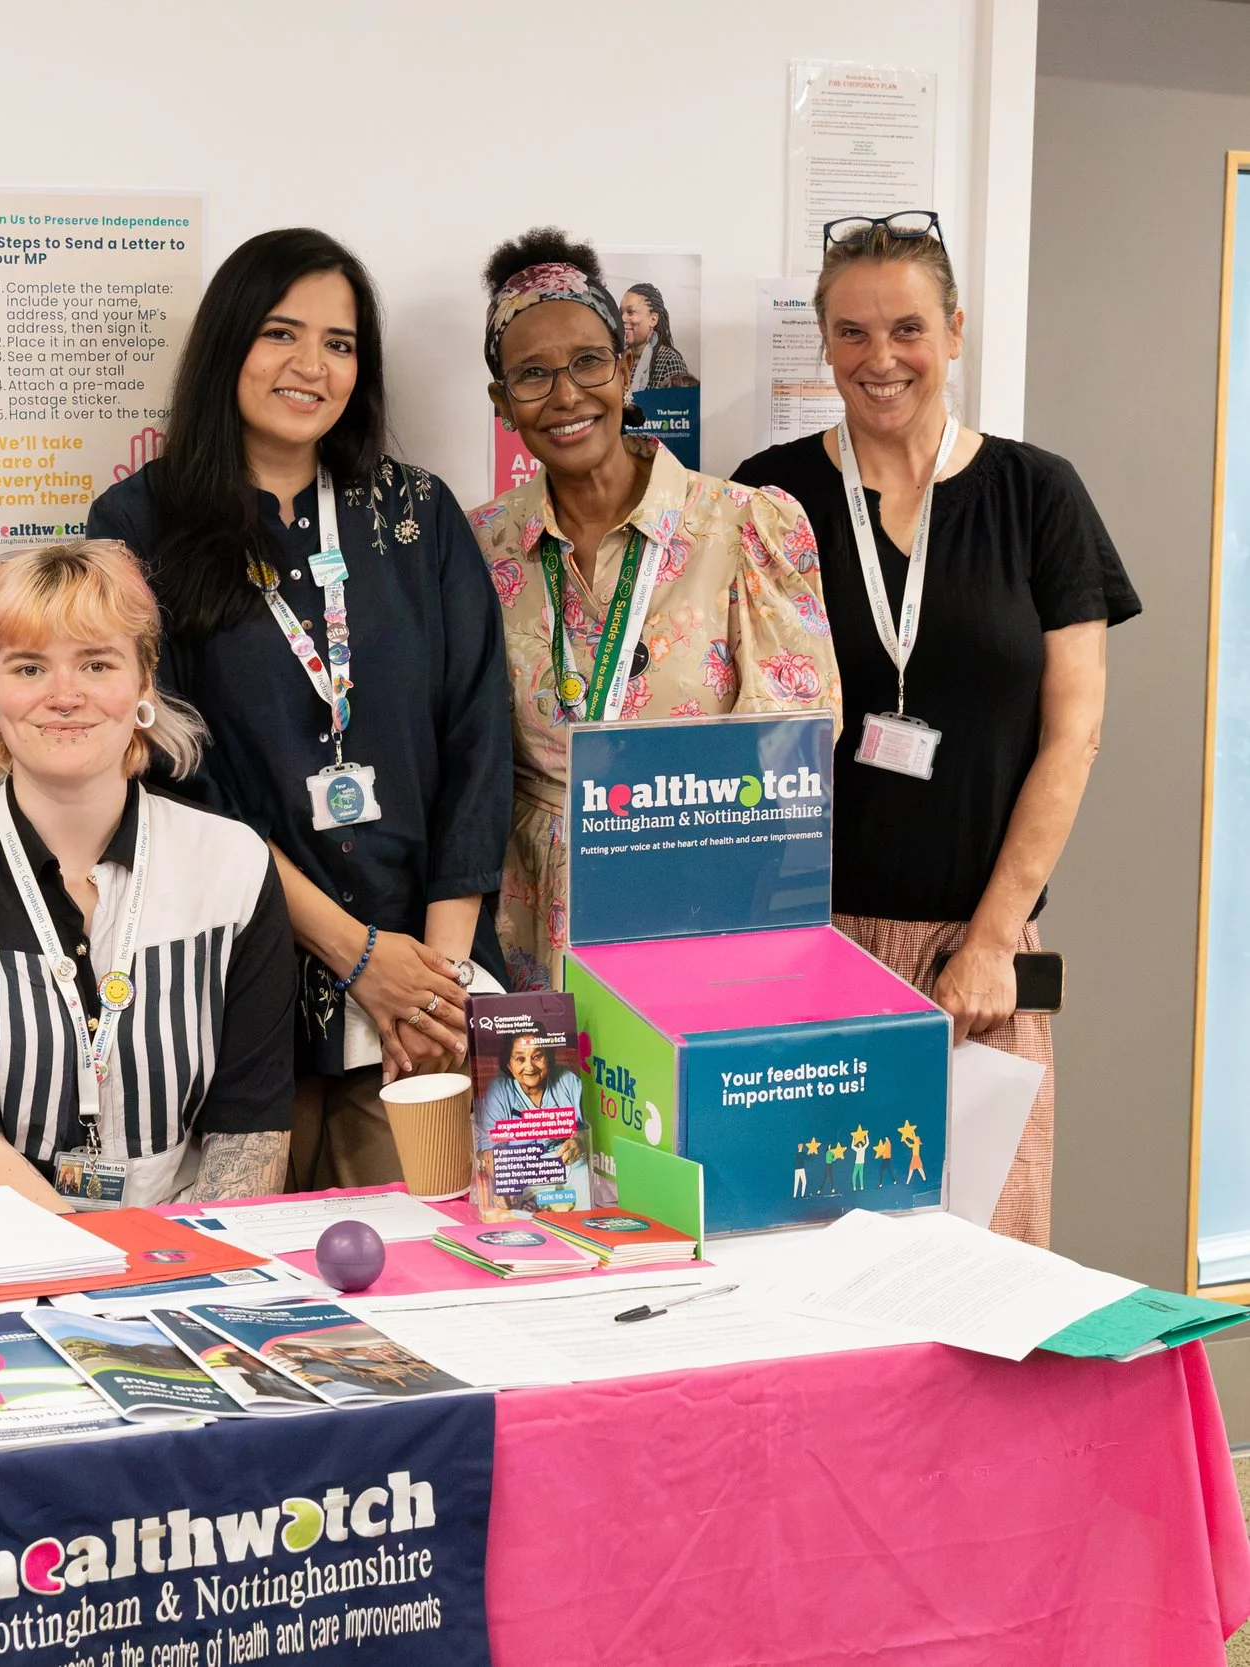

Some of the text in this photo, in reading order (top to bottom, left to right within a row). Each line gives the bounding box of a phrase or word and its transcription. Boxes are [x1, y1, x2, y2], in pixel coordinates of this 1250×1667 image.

[828, 80, 898, 90] FIRE EMERGENCY PLAN
[10, 215, 25, 225] Us
[28, 215, 41, 225] to
[44, 215, 99, 226] Preserve
[102, 216, 189, 229] Independence
[45, 238, 60, 249] to
[65, 237, 103, 250] Send
[108, 241, 117, 250] a
[121, 238, 166, 250] Letter
[170, 239, 185, 250] to
[24, 253, 47, 265] MP
[80, 282, 173, 296] the template:
[6, 295, 141, 310] include your name,
[6, 309, 167, 323] address, and your MP's
[7, 322, 152, 337] address, then sign it.
[50, 335, 169, 350] it in an envelope.
[51, 350, 155, 362] member of our
[7, 365, 125, 376] team at our stall
[73, 378, 145, 394] pre-made
[8, 394, 121, 409] postage sticker.
[64, 407, 139, 420] over to the
[42, 435, 83, 450] take
[38, 453, 55, 469] of
[40, 490, 96, 506] there!
[633, 584, 648, 616] Inclusion
[588, 600, 626, 716] Suicide ok to talk about
[582, 766, 823, 817] healthwatch
[581, 803, 823, 833] Nottingham & Nottinghamshire
[580, 830, 823, 855] Putting your voice at the heart of health and care improvements
[5, 831, 46, 924] Inclusion Compassion
[120, 821, 148, 960] Inclusion Compassion Integrity
[493, 1014, 532, 1023] Community
[721, 1058, 868, 1087] Your feedback is
[592, 1055, 643, 1131] Talk to Us
[722, 1077, 865, 1108] important to us!
[524, 1110, 574, 1120] Sharing your
[497, 1119, 574, 1131] experience help
[515, 1130, 548, 1138] services
[555, 1192, 563, 1200] to
[155, 1581, 183, 1623] &
[195, 1544, 434, 1621] Nottinghamshire
[206, 1592, 442, 1667] of health and care improvements
